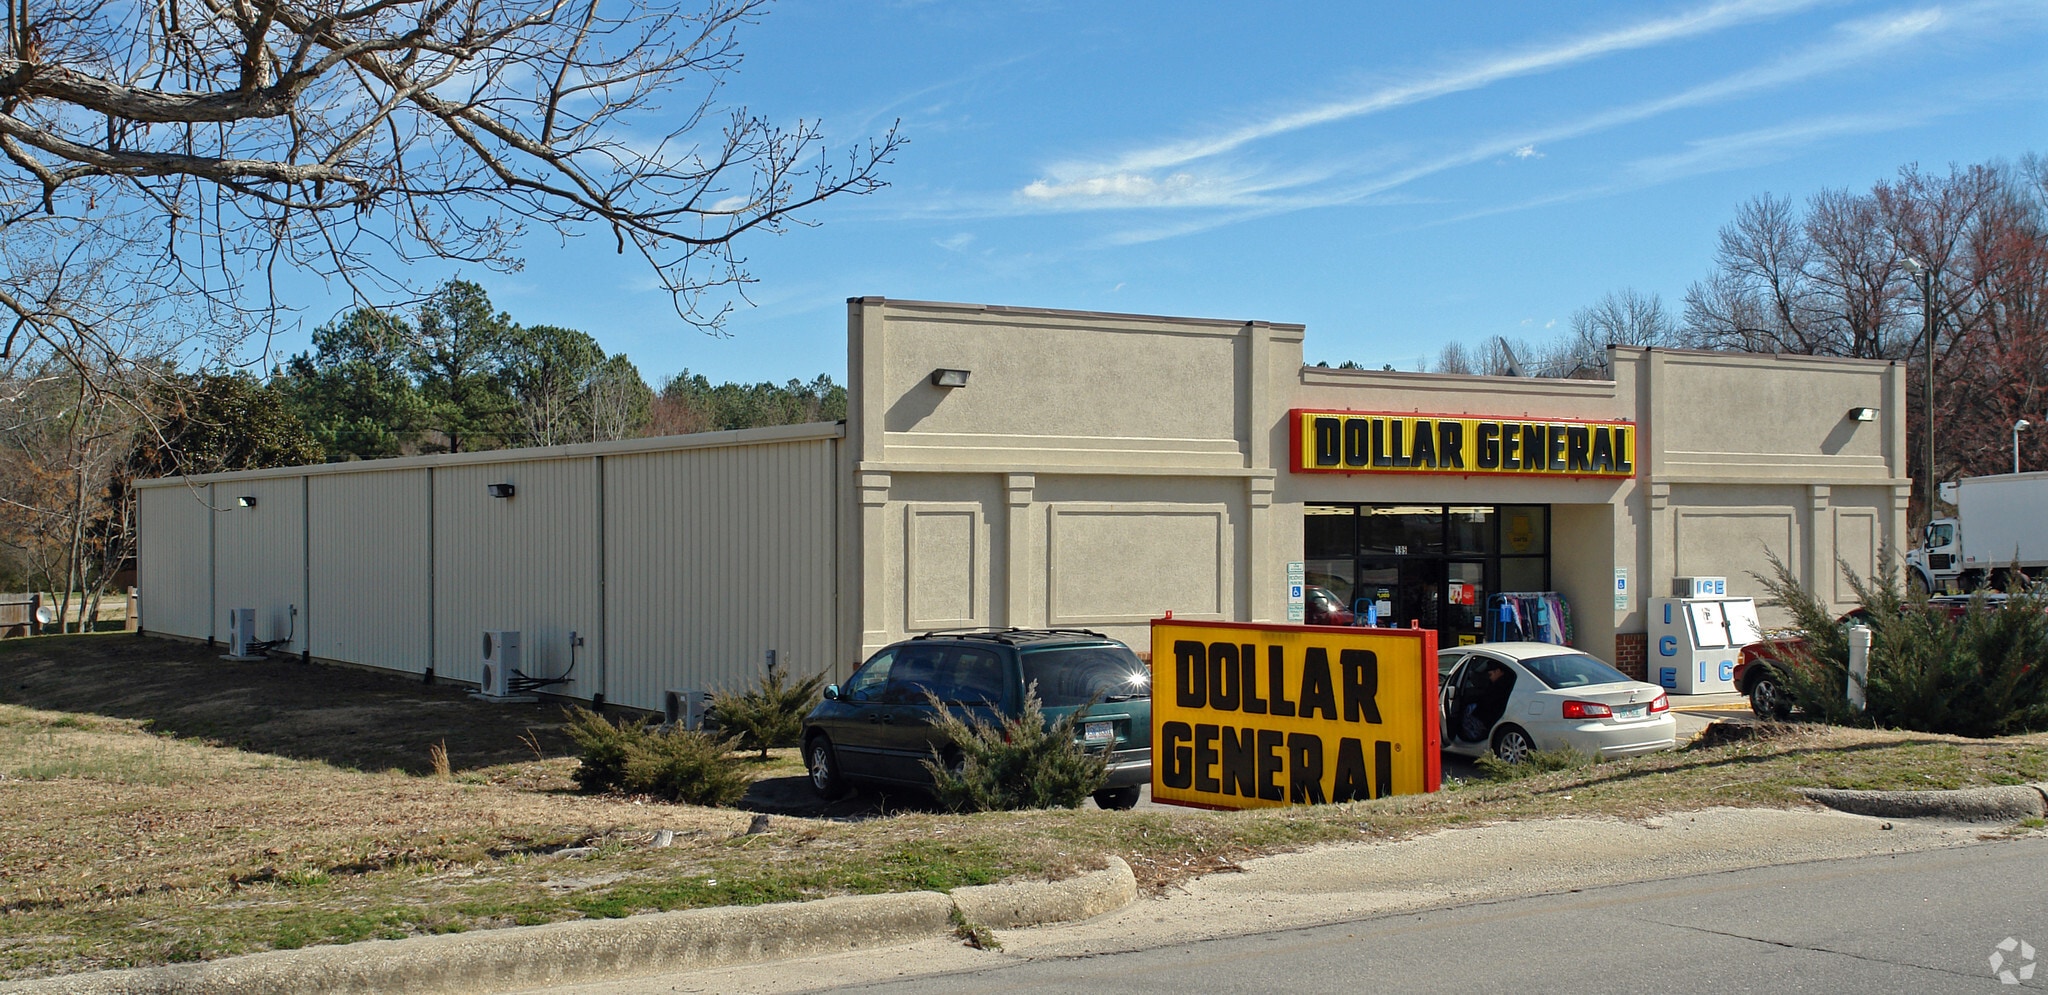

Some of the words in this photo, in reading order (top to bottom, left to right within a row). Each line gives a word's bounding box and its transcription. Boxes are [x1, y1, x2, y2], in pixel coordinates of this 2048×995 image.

[1315, 417, 1464, 468] DOLLAR
[1477, 422, 1632, 472] GENERAL
[1697, 580, 1725, 595] ICE
[1659, 603, 1678, 689] ICE
[1699, 660, 1734, 683] IC
[1174, 640, 1383, 725] DOLLAR
[1162, 720, 1393, 805] GENERAL
